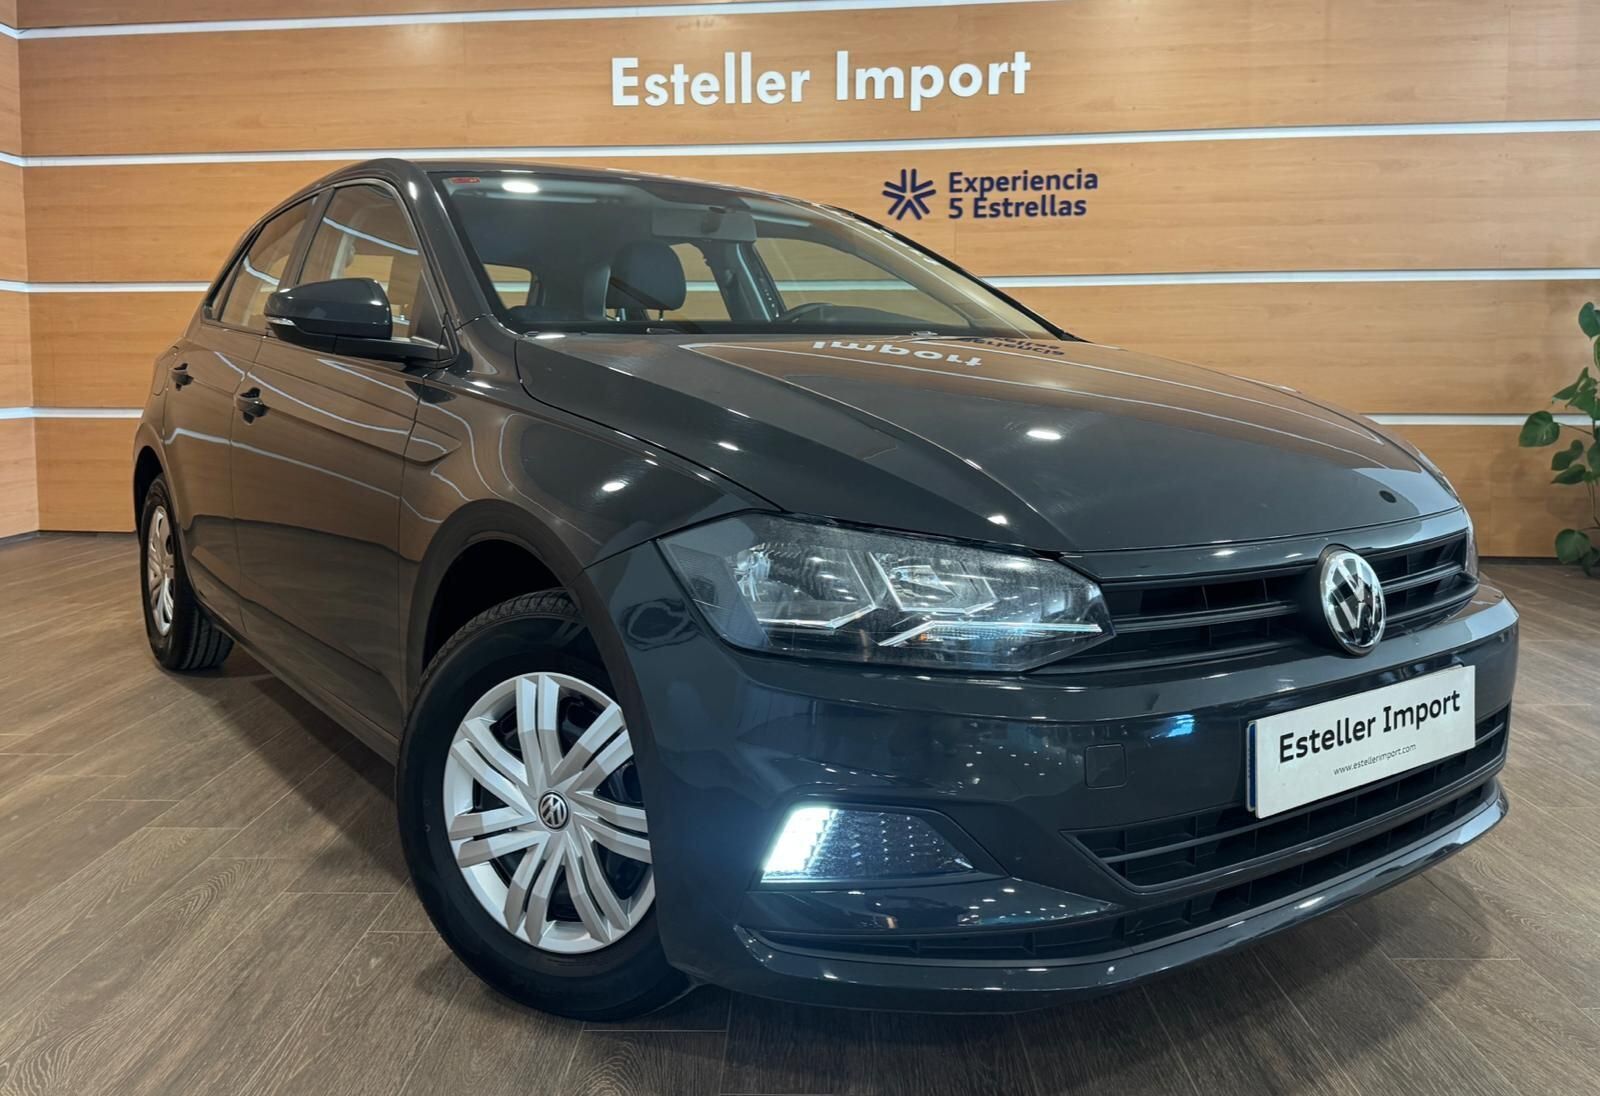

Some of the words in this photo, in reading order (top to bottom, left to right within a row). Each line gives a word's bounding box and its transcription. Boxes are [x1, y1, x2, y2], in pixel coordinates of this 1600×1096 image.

[611, 51, 810, 106] Esteller
[836, 50, 1031, 112] Import
[949, 168, 1098, 199] Experiencia
[948, 198, 963, 219] 5
[973, 194, 1087, 218] Estrellas
[1279, 717, 1376, 763] Esteller
[1383, 690, 1460, 730] Import
[1333, 743, 1417, 776] www.estellerimport.com
